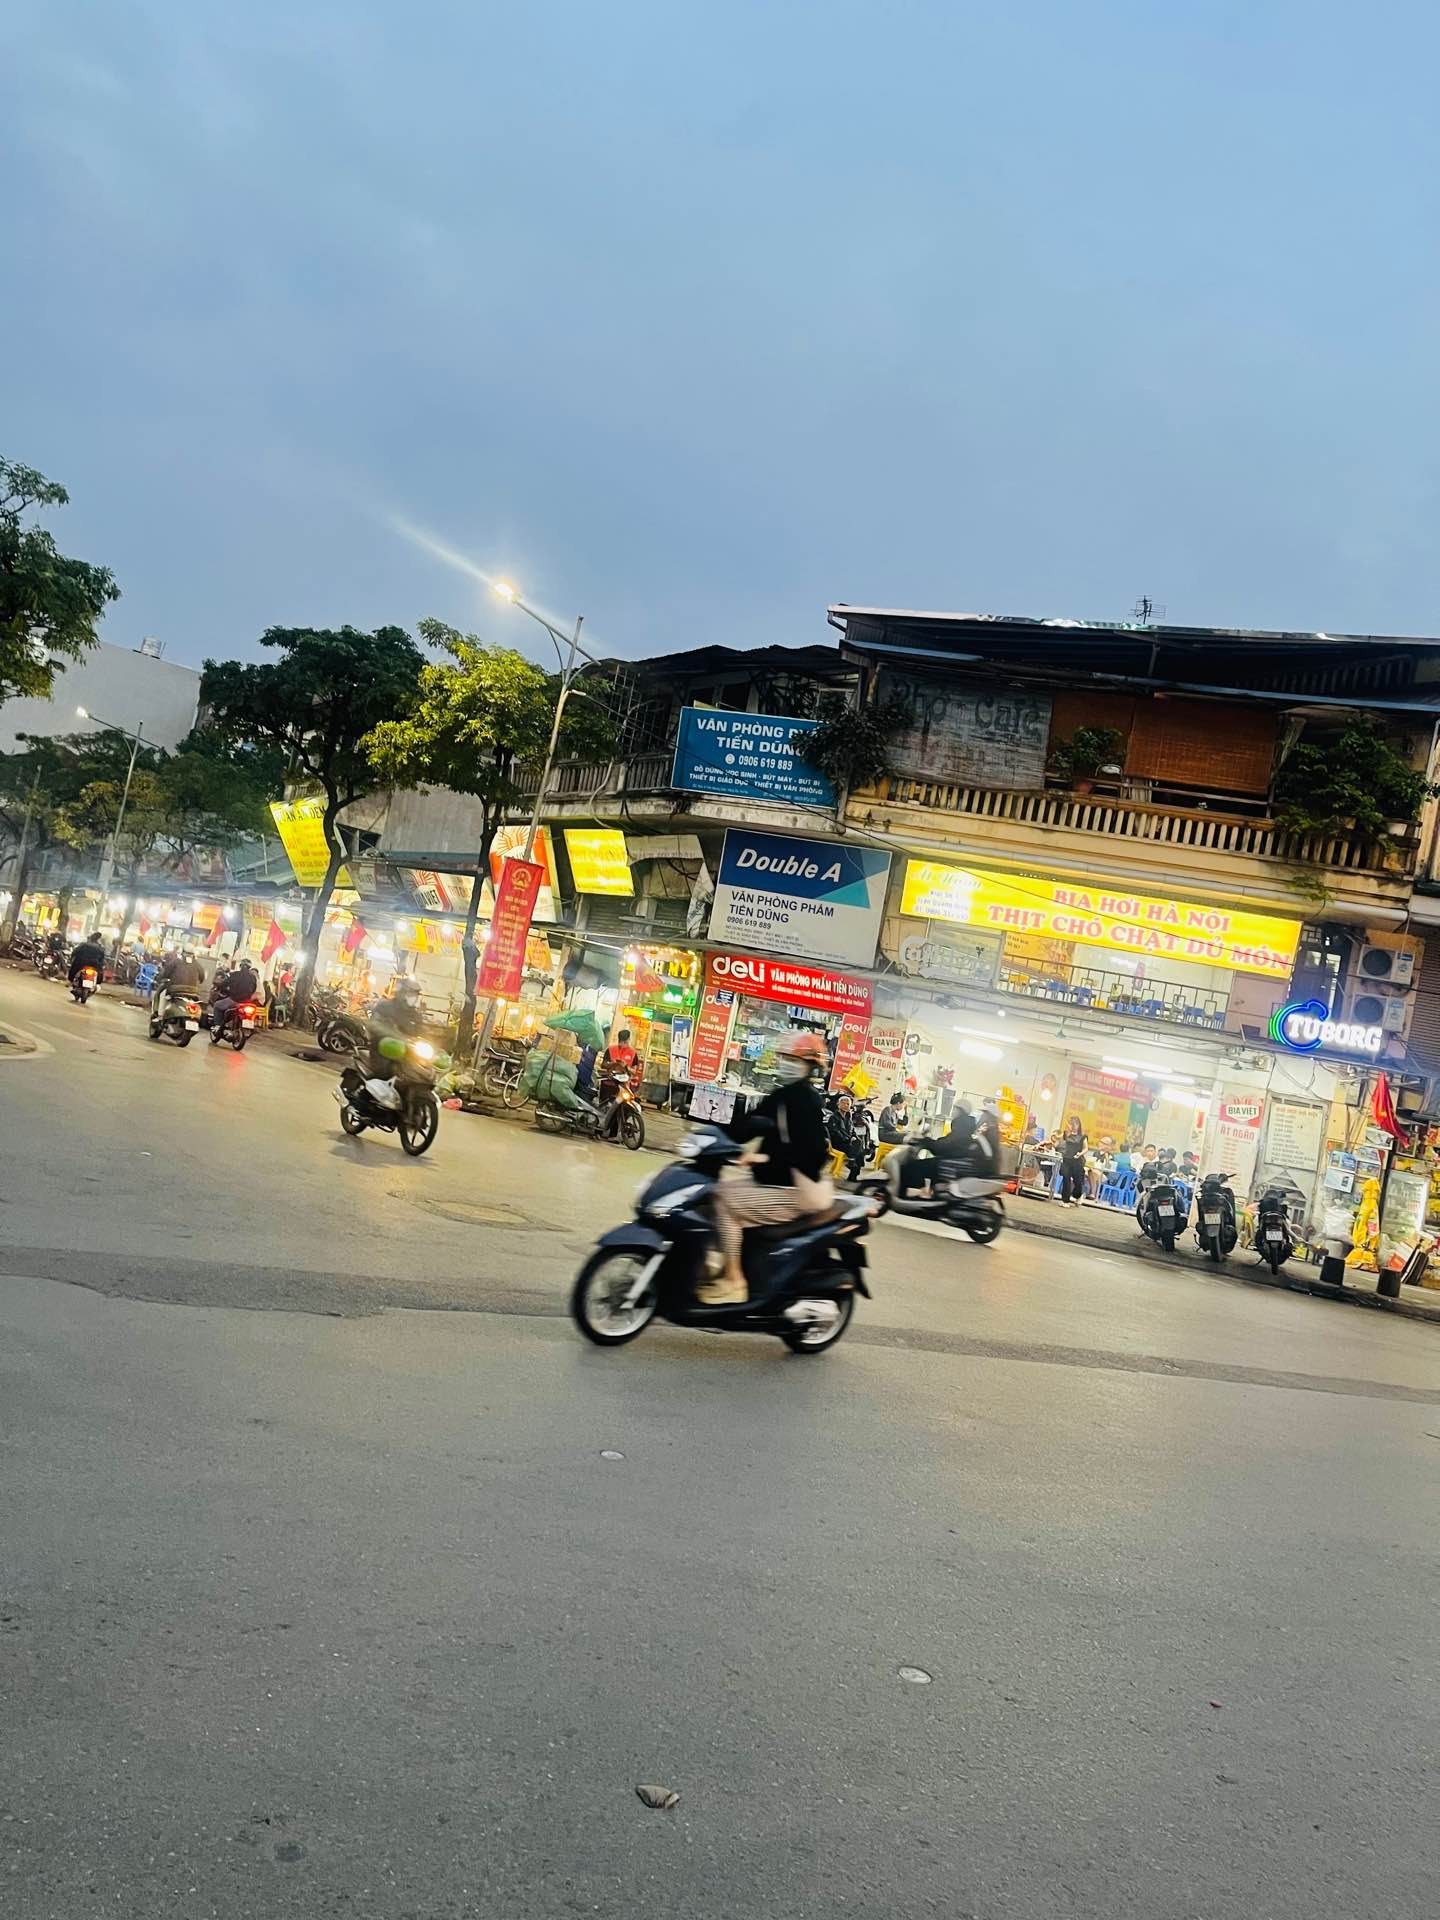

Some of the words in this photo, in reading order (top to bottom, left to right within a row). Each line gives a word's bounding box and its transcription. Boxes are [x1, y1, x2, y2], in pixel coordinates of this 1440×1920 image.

[732, 721, 784, 737] PHÒNG
[716, 735, 754, 751] TIẾN
[738, 755, 759, 767] 0906
[760, 757, 776, 769] 619
[777, 759, 793, 771] 889
[736, 848, 818, 879] Double
[820, 862, 842, 883] A
[731, 890, 755, 905] VĂN
[757, 894, 798, 911] PHÒNG
[1054, 888, 1091, 909] BIA
[1100, 896, 1139, 917] HƠI
[1147, 904, 1179, 923] HÀ
[1188, 911, 1231, 933] NỘI
[727, 916, 744, 926] 0906
[744, 919, 757, 928] 619
[988, 905, 1046, 931] THỊT
[1052, 917, 1103, 938] CHÓ
[712, 957, 765, 983] deli
[786, 971, 811, 987] PHÒNG
[844, 1023, 867, 1034] deli
[1288, 1014, 1382, 1052] TUBORG
[874, 1038, 886, 1047] BIA
[1228, 1106, 1240, 1115] BIA
